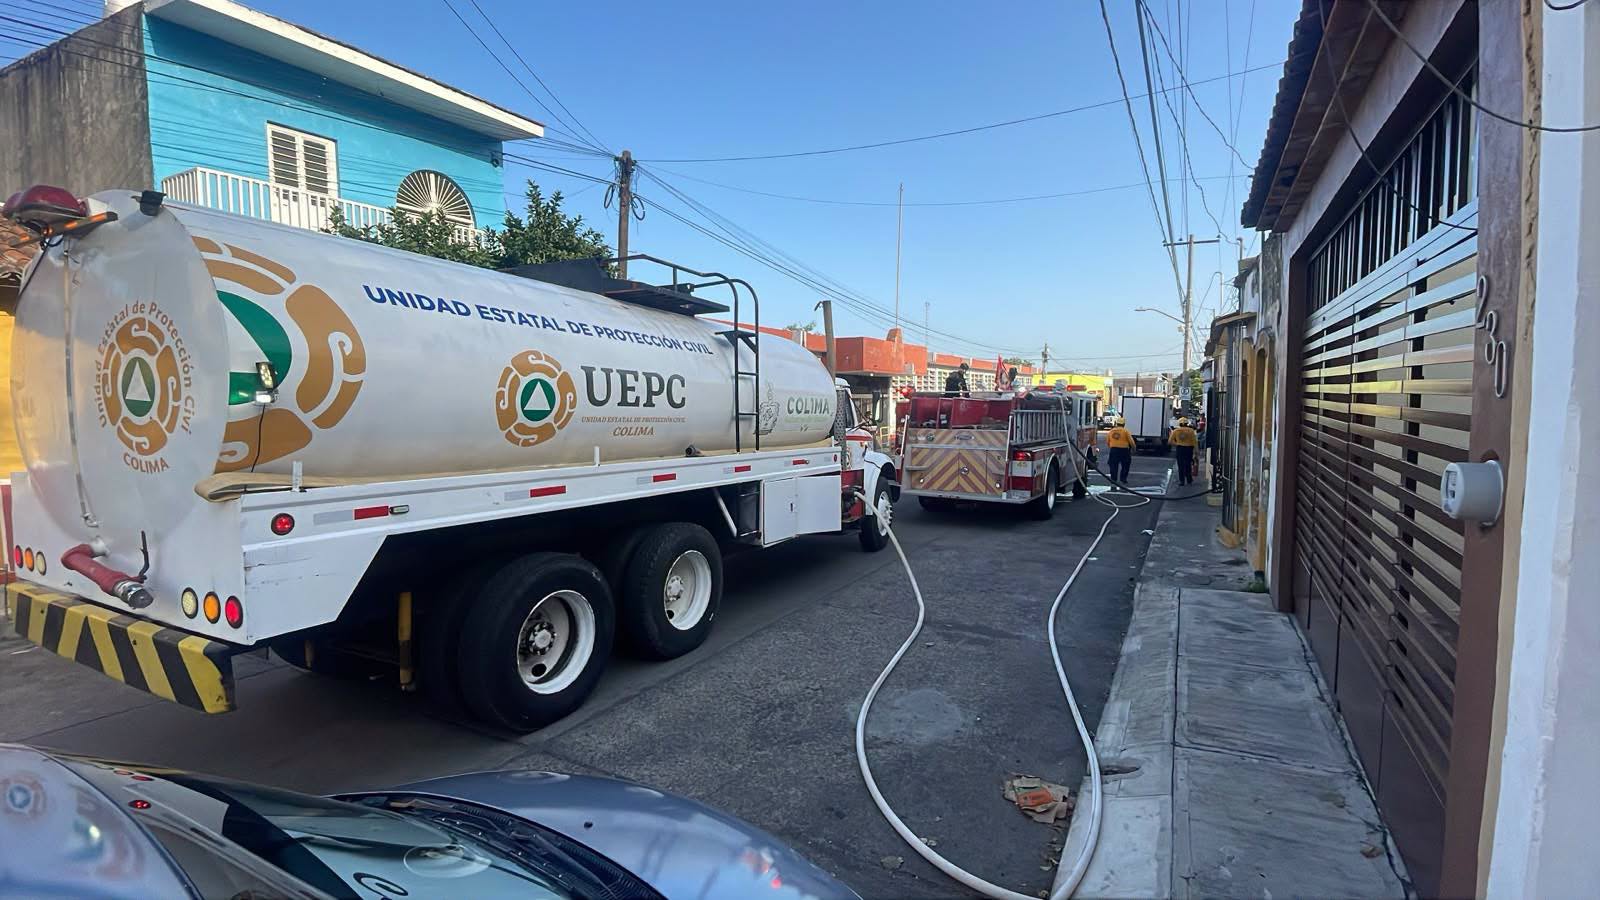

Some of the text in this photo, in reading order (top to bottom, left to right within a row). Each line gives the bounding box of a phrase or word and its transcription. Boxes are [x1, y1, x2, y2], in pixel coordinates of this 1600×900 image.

[363, 284, 714, 355] UNIDAD ESTATAL DE PROTECCIÓN CIVIL
[132, 300, 146, 314] de
[149, 302, 194, 387] Protección
[580, 365, 686, 409] UEPC
[787, 396, 830, 415] COLIMA
[612, 426, 654, 436] COLIMA
[123, 452, 170, 474] COLIMA
